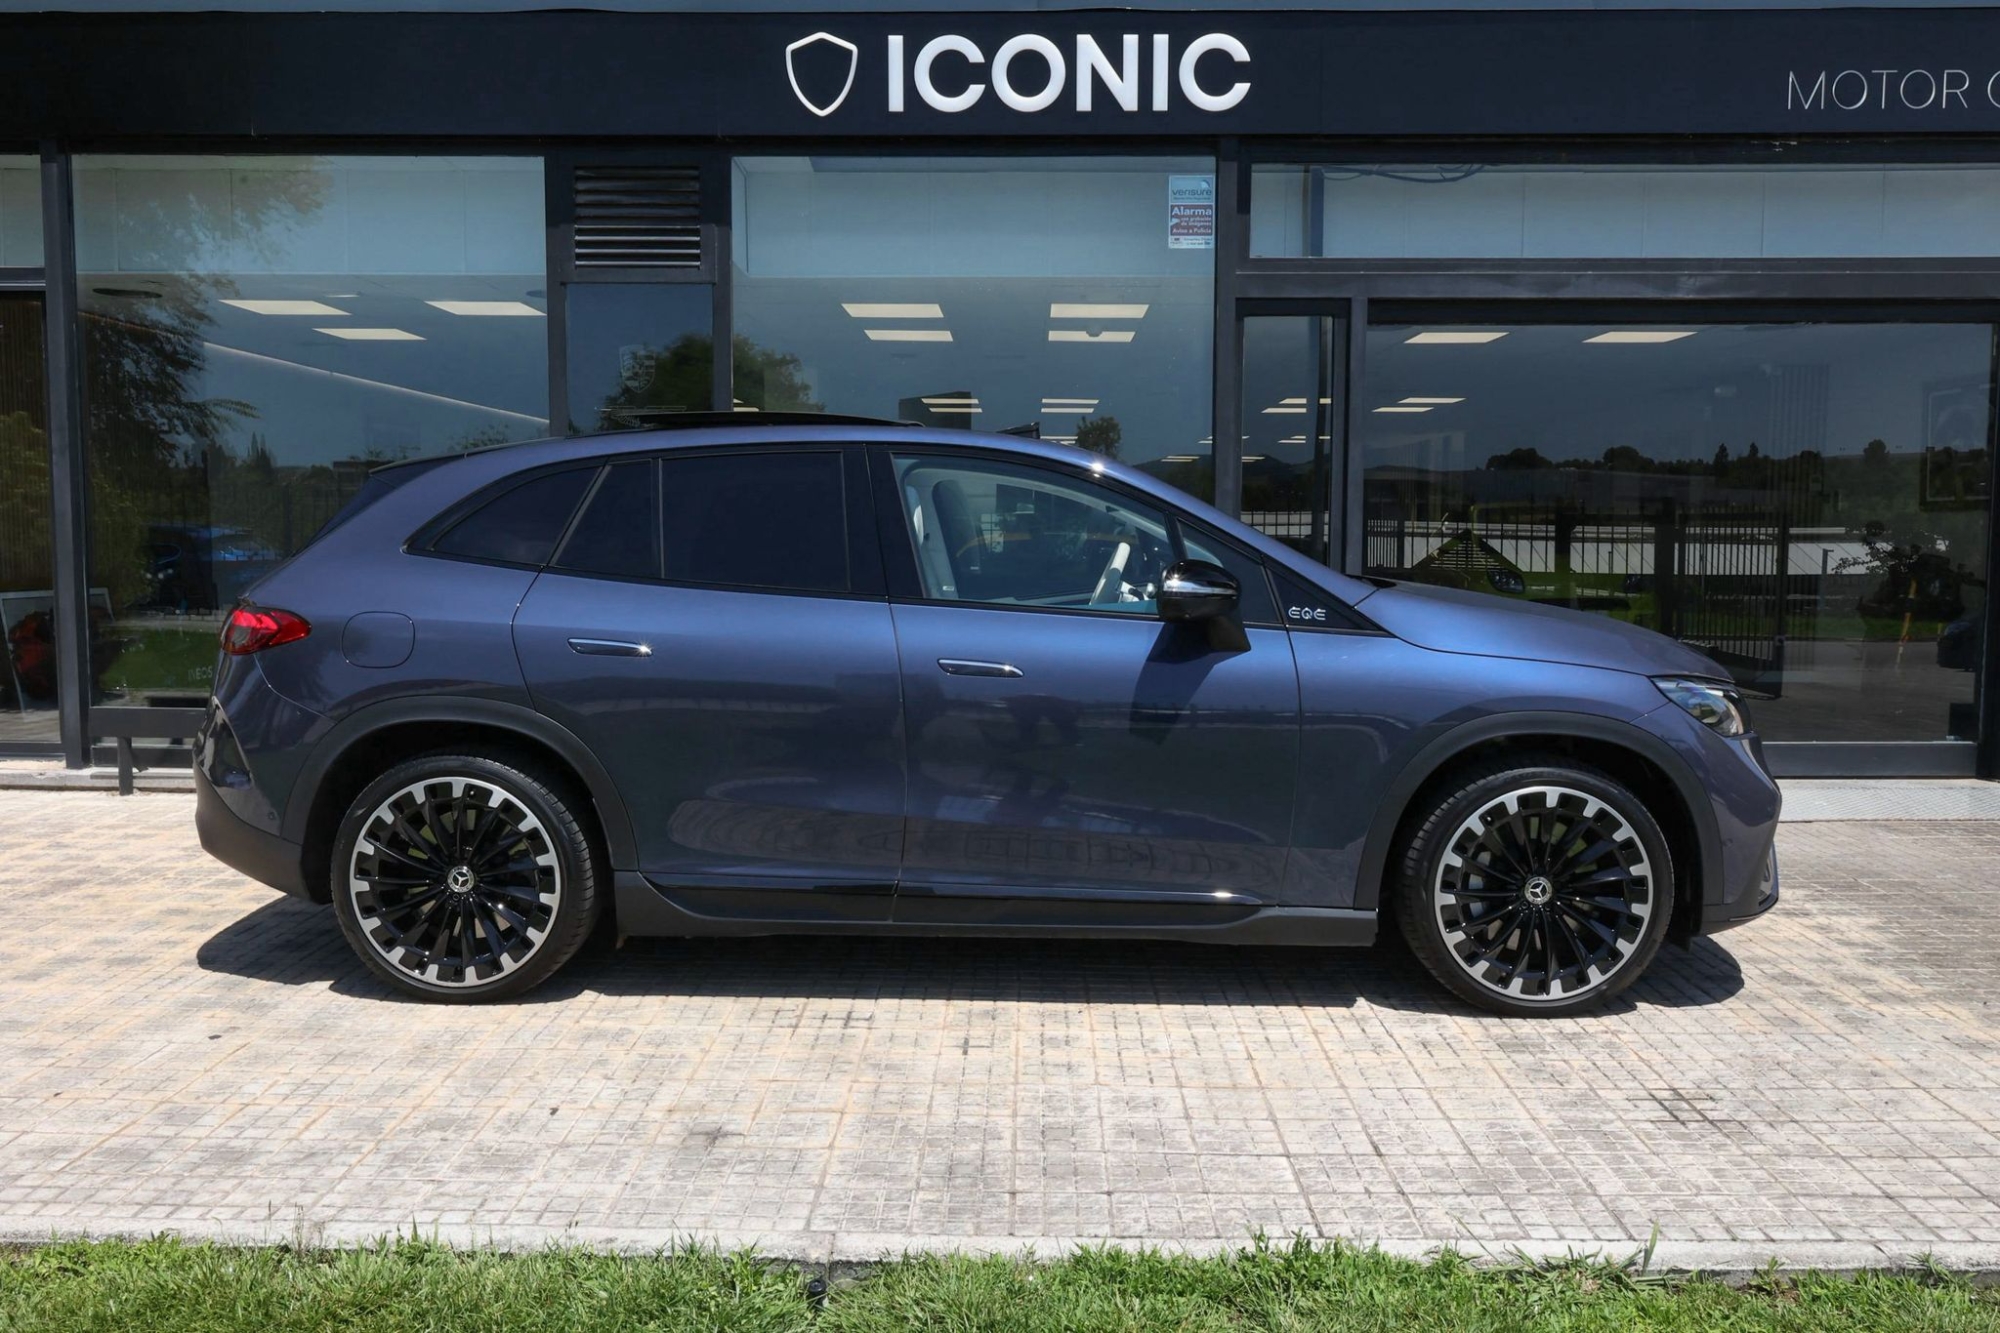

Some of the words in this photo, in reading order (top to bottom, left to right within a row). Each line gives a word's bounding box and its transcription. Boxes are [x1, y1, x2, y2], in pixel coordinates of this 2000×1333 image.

[887, 32, 1252, 113] ICONIC
[1787, 69, 1970, 110] MOTOR
[1171, 188, 1212, 196] verisure
[1171, 206, 1212, 216] Alarma
[1288, 606, 1326, 621] EQE
